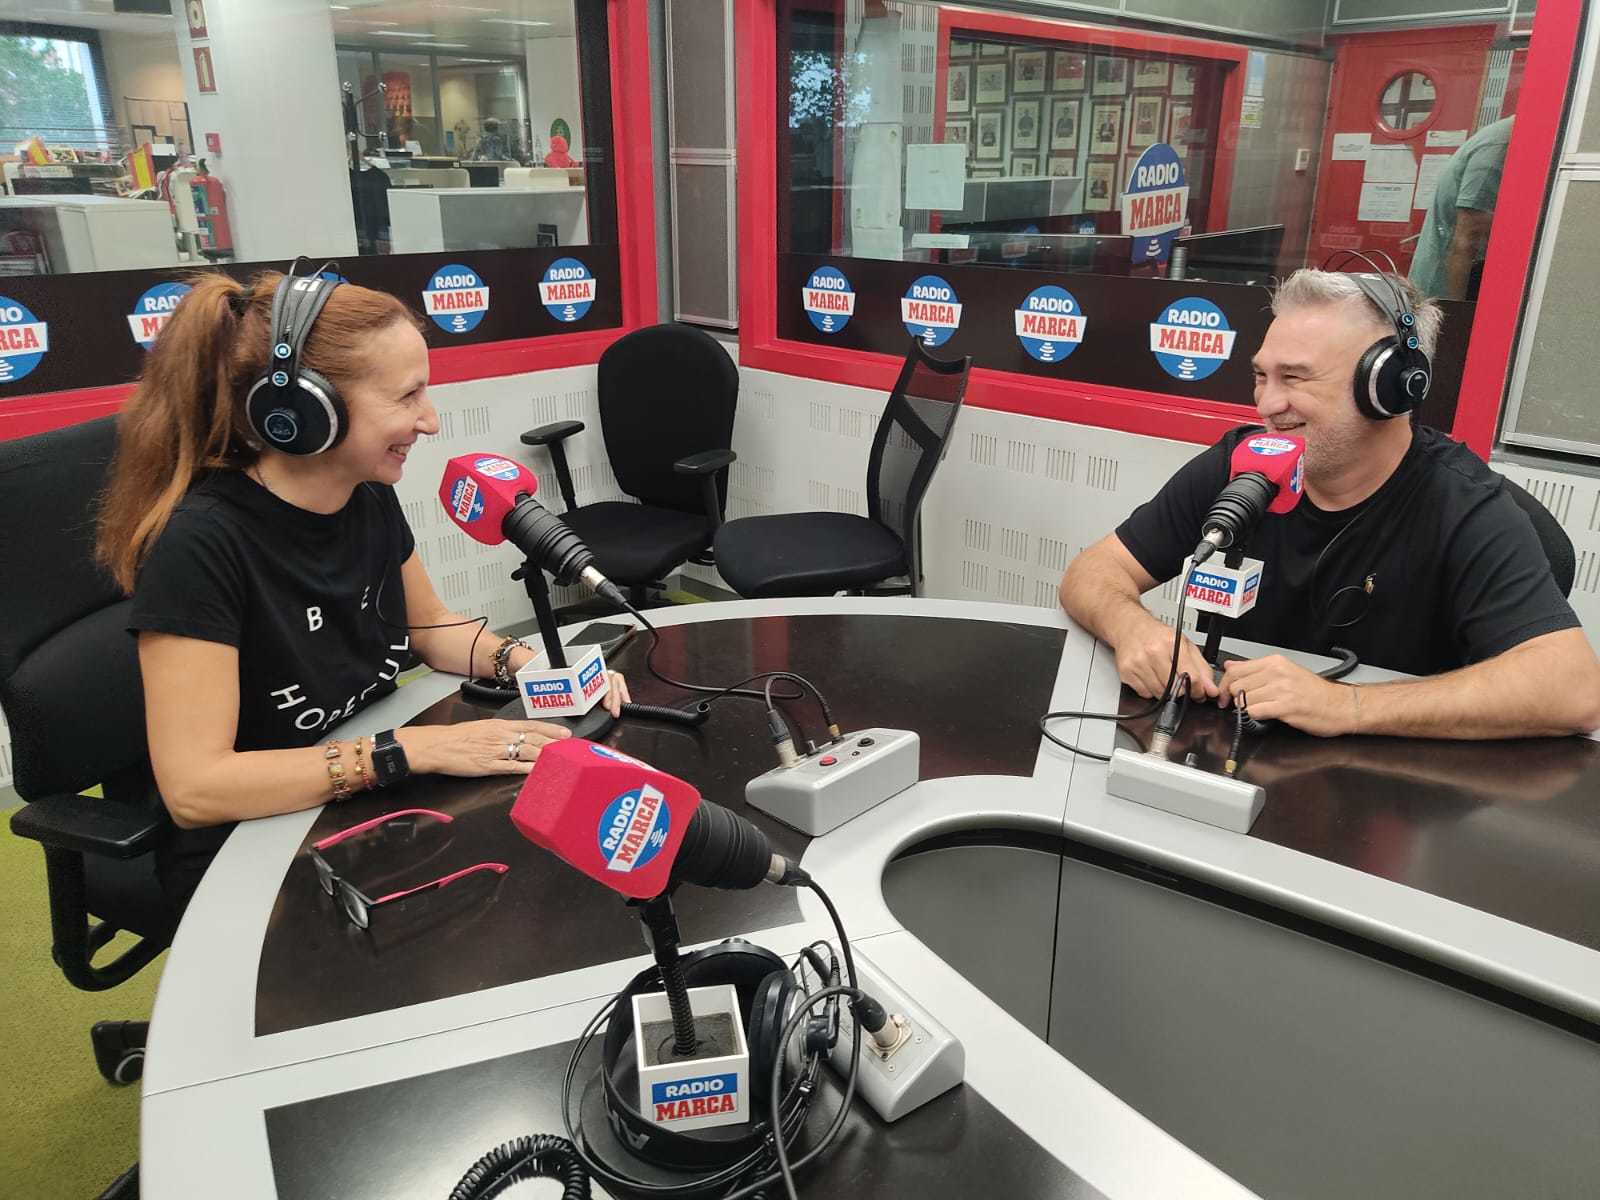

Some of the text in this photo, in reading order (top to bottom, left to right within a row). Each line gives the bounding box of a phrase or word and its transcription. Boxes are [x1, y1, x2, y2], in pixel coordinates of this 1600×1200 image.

[1138, 162, 1179, 188] RADIO
[1130, 192, 1182, 230] MARCA
[435, 274, 475, 289] RADIO
[550, 267, 585, 281] RADIO
[812, 276, 845, 290] RADIO
[432, 290, 483, 310] MARCA
[546, 282, 591, 301] MARCA
[809, 291, 849, 311] MARCA
[912, 286, 950, 300] RADIO
[144, 294, 184, 311] RAD
[908, 302, 955, 323] MARCA
[1029, 297, 1074, 313] RADIO
[1023, 314, 1078, 338] MARCA
[1168, 309, 1220, 327] RADIO
[0, 327, 39, 350] RCA
[1159, 328, 1224, 354] MARCA
[458, 483, 476, 518] MARCA
[1195, 574, 1229, 589] RADIO
[1185, 584, 1231, 606] MARCA
[532, 682, 564, 693] RADIO
[582, 672, 605, 700] MARCA
[530, 693, 574, 708] MARCA
[602, 796, 636, 850] RADIO
[616, 796, 659, 864] MARCA
[666, 1079, 724, 1098] RADIO
[656, 1094, 734, 1121] MARCA
